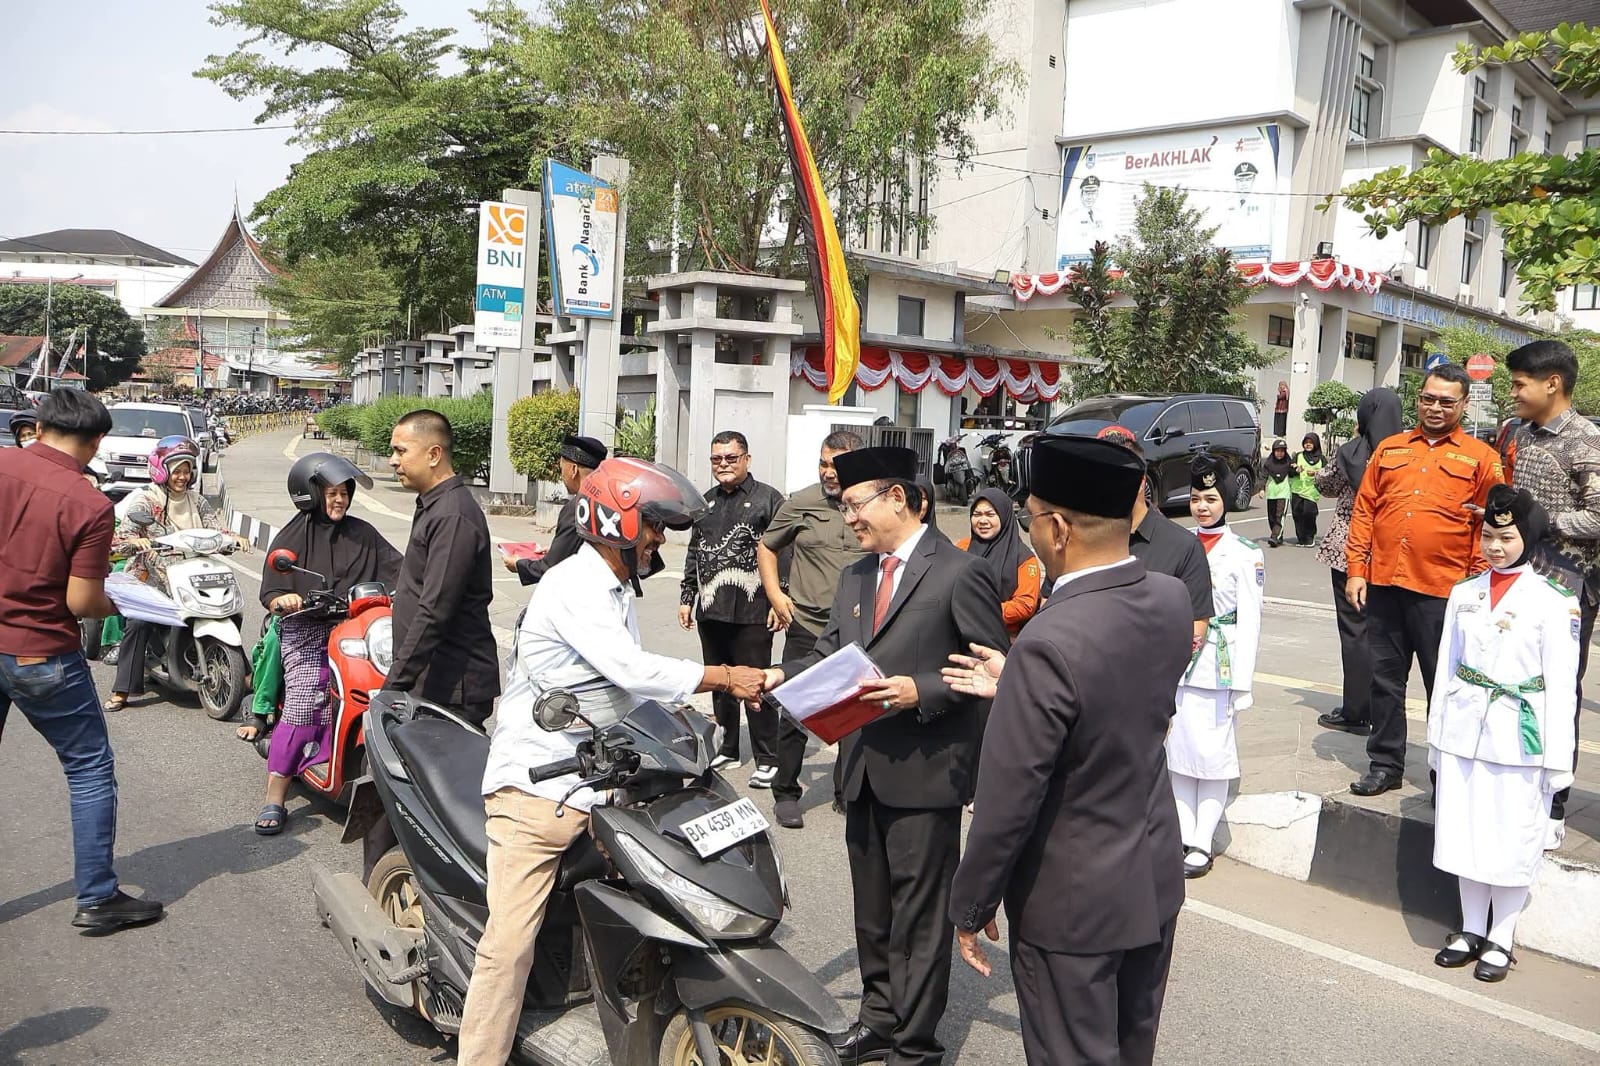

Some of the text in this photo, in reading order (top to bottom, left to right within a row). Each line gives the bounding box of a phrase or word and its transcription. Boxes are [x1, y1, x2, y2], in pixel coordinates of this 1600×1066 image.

[1125, 147, 1211, 170] BerAKHLAK
[486, 248, 522, 269] BNI
[579, 202, 593, 295] Bank Nagari
[482, 288, 506, 300] ATM
[504, 303, 520, 316] 24
[686, 801, 757, 842] BA 4539 MN
